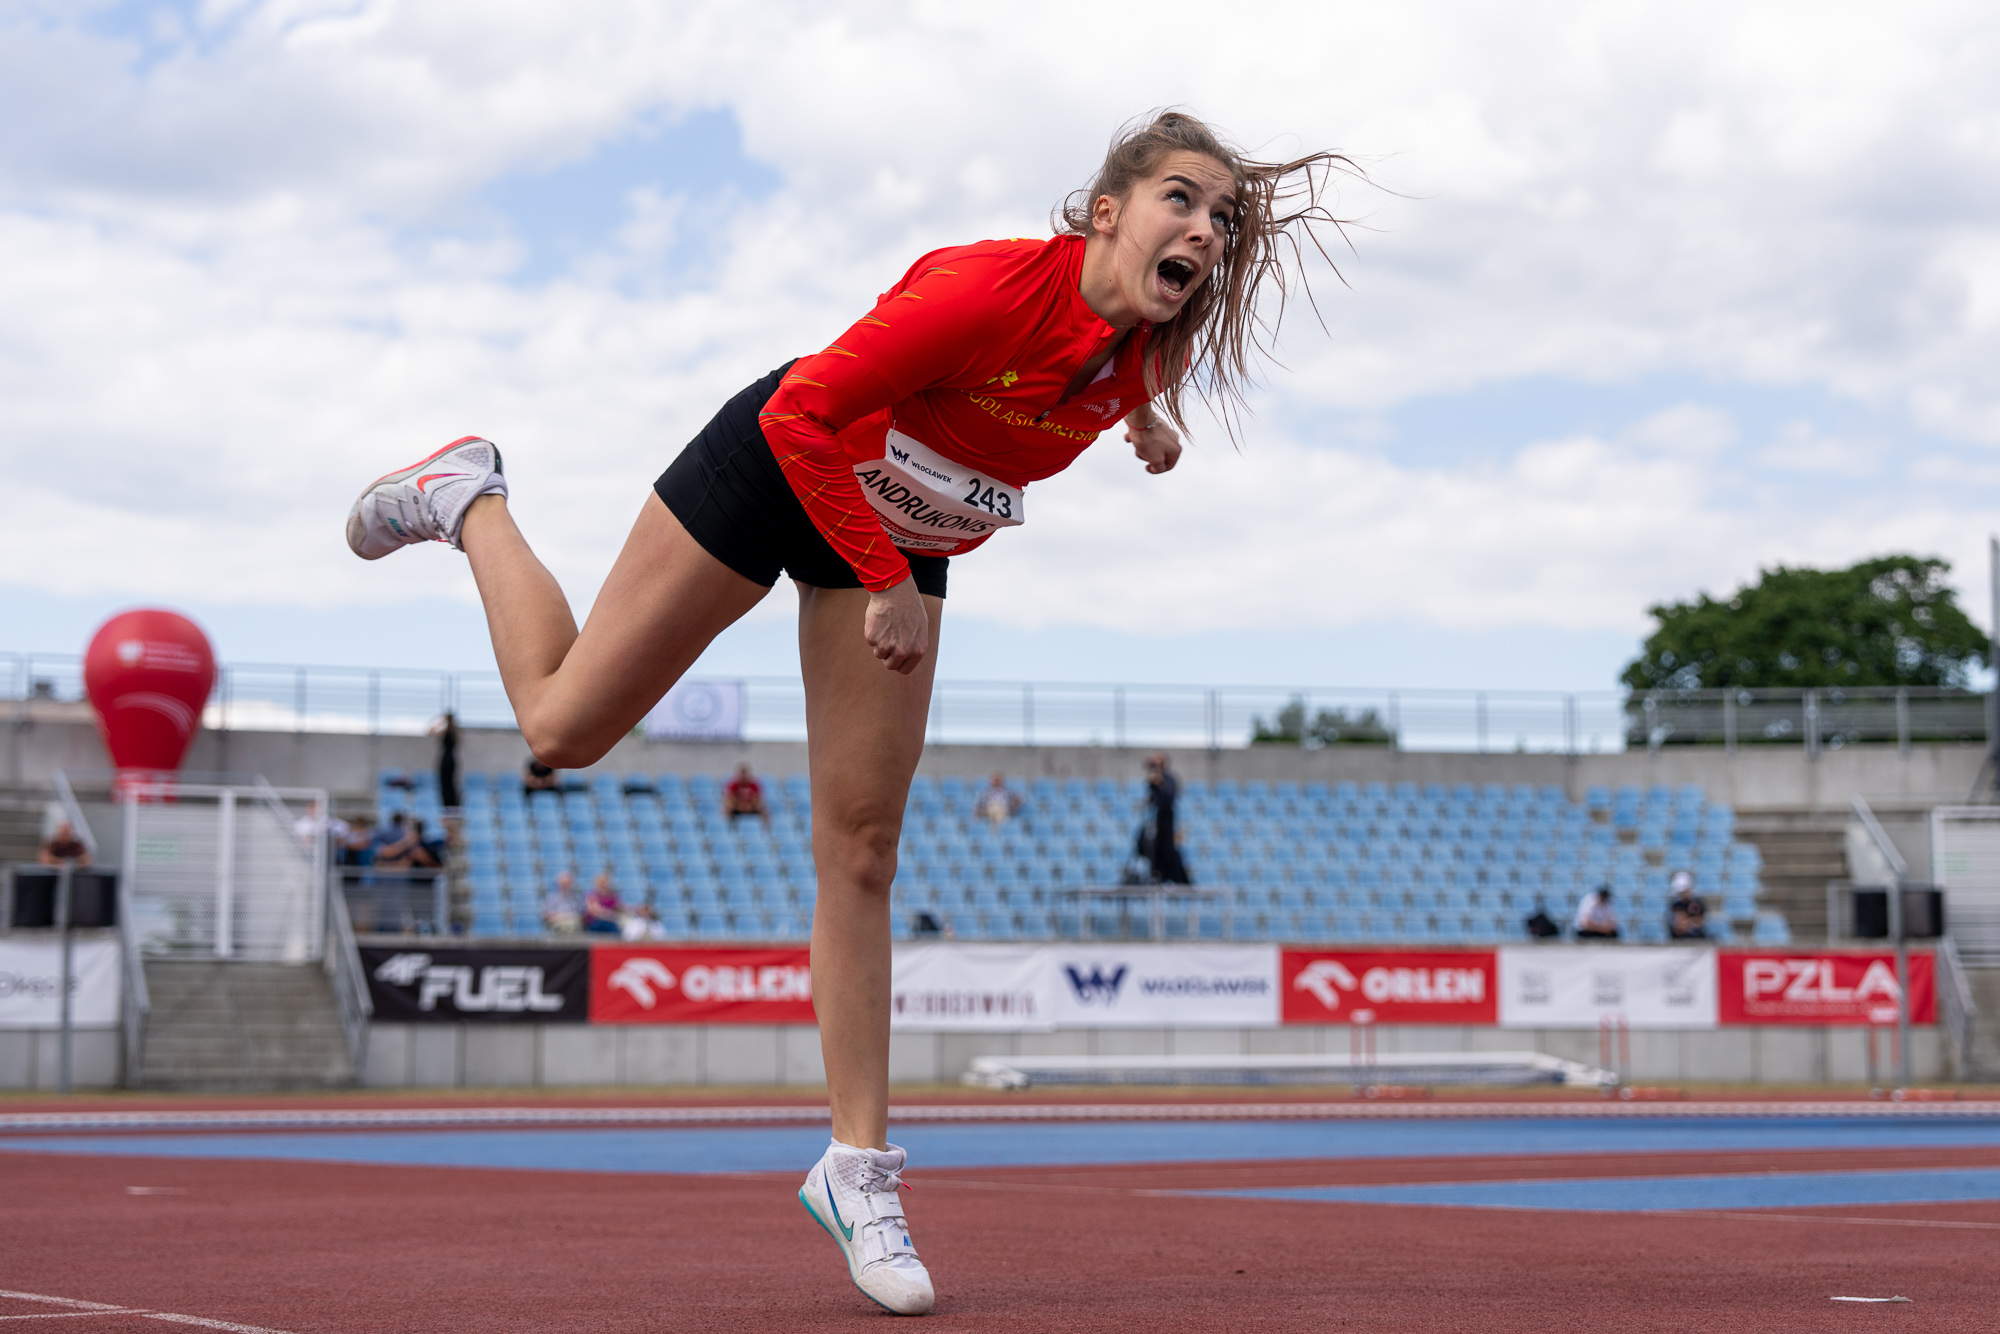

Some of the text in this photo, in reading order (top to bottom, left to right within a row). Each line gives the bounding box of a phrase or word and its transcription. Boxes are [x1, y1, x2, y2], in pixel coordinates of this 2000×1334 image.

[911, 460, 953, 484] WŁOCŁAWEK
[855, 468, 996, 533] ANDRUKONIS
[963, 478, 1012, 519] 243
[909, 540, 940, 548] 2023
[418, 965, 566, 1012] FUEL
[1360, 966, 1486, 1003] ORLEN
[1743, 958, 1904, 1001] PZLA
